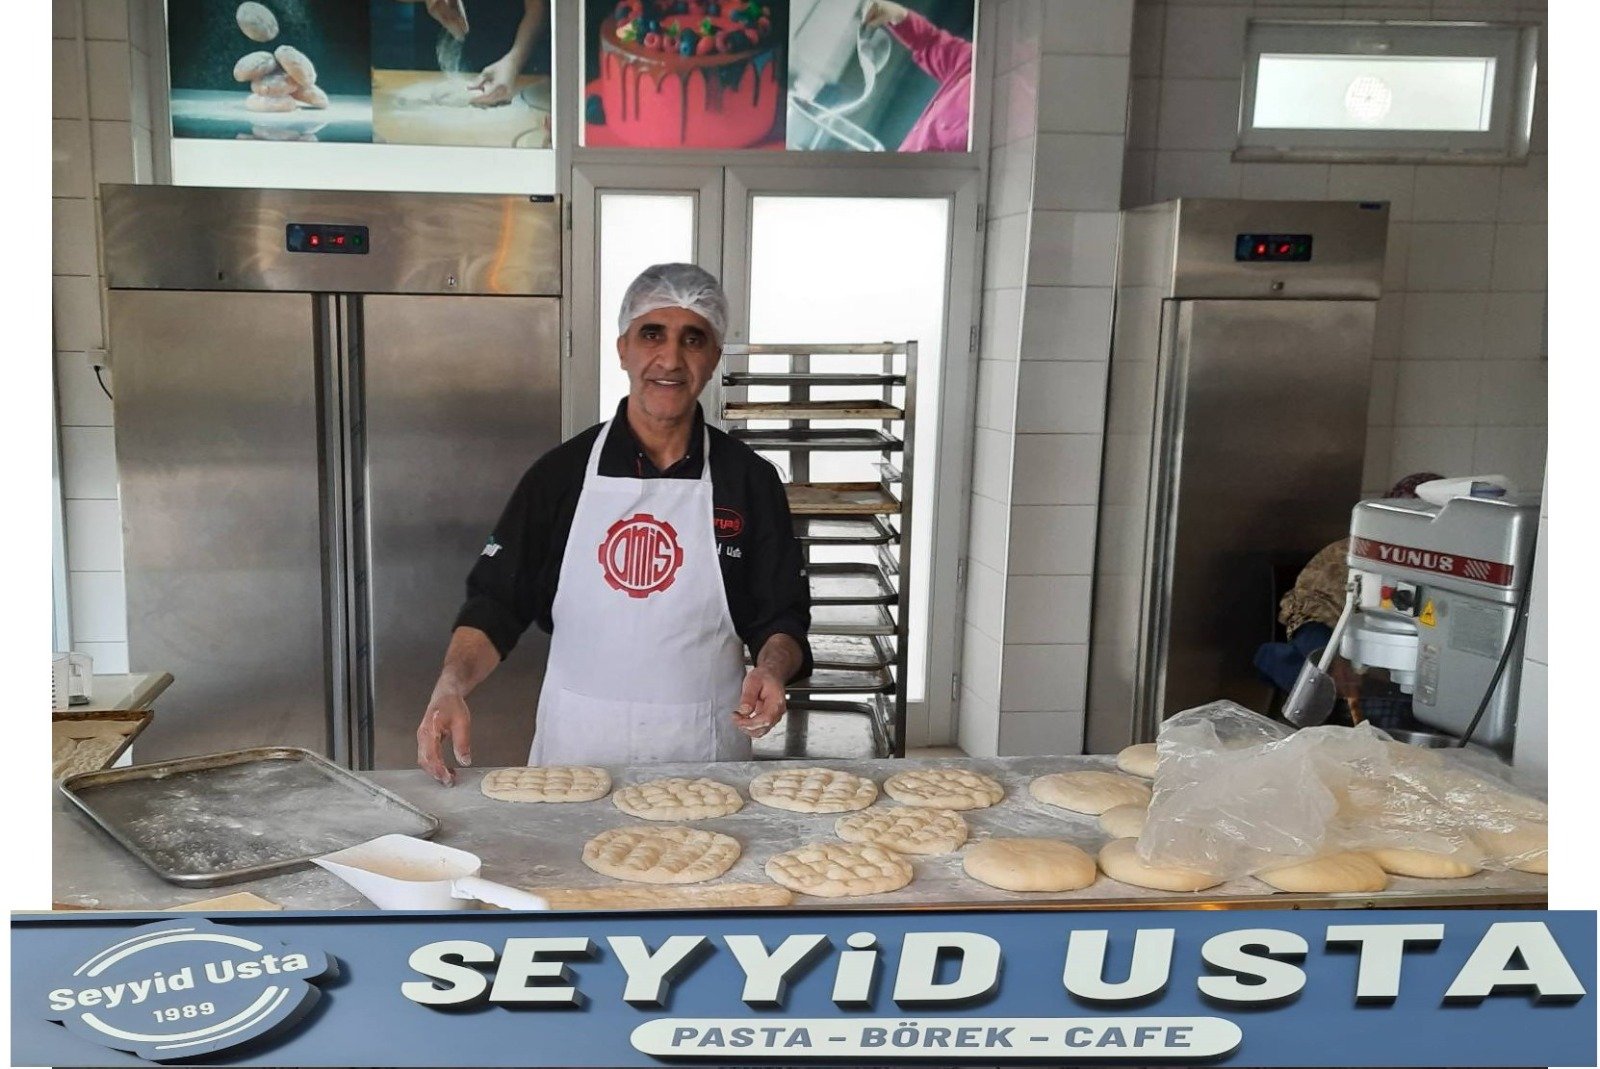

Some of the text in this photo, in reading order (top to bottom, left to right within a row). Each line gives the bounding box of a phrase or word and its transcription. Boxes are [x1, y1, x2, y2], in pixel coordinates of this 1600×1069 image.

[1379, 545, 1455, 572] YUNUS
[1063, 921, 1587, 1003] USTA
[48, 952, 309, 1011] Seyyid Usta
[153, 1002, 215, 1023] 1989
[671, 1027, 813, 1048] PASTA
[860, 1021, 1016, 1048] BÖREK
[1064, 1026, 1194, 1048] CAFE
